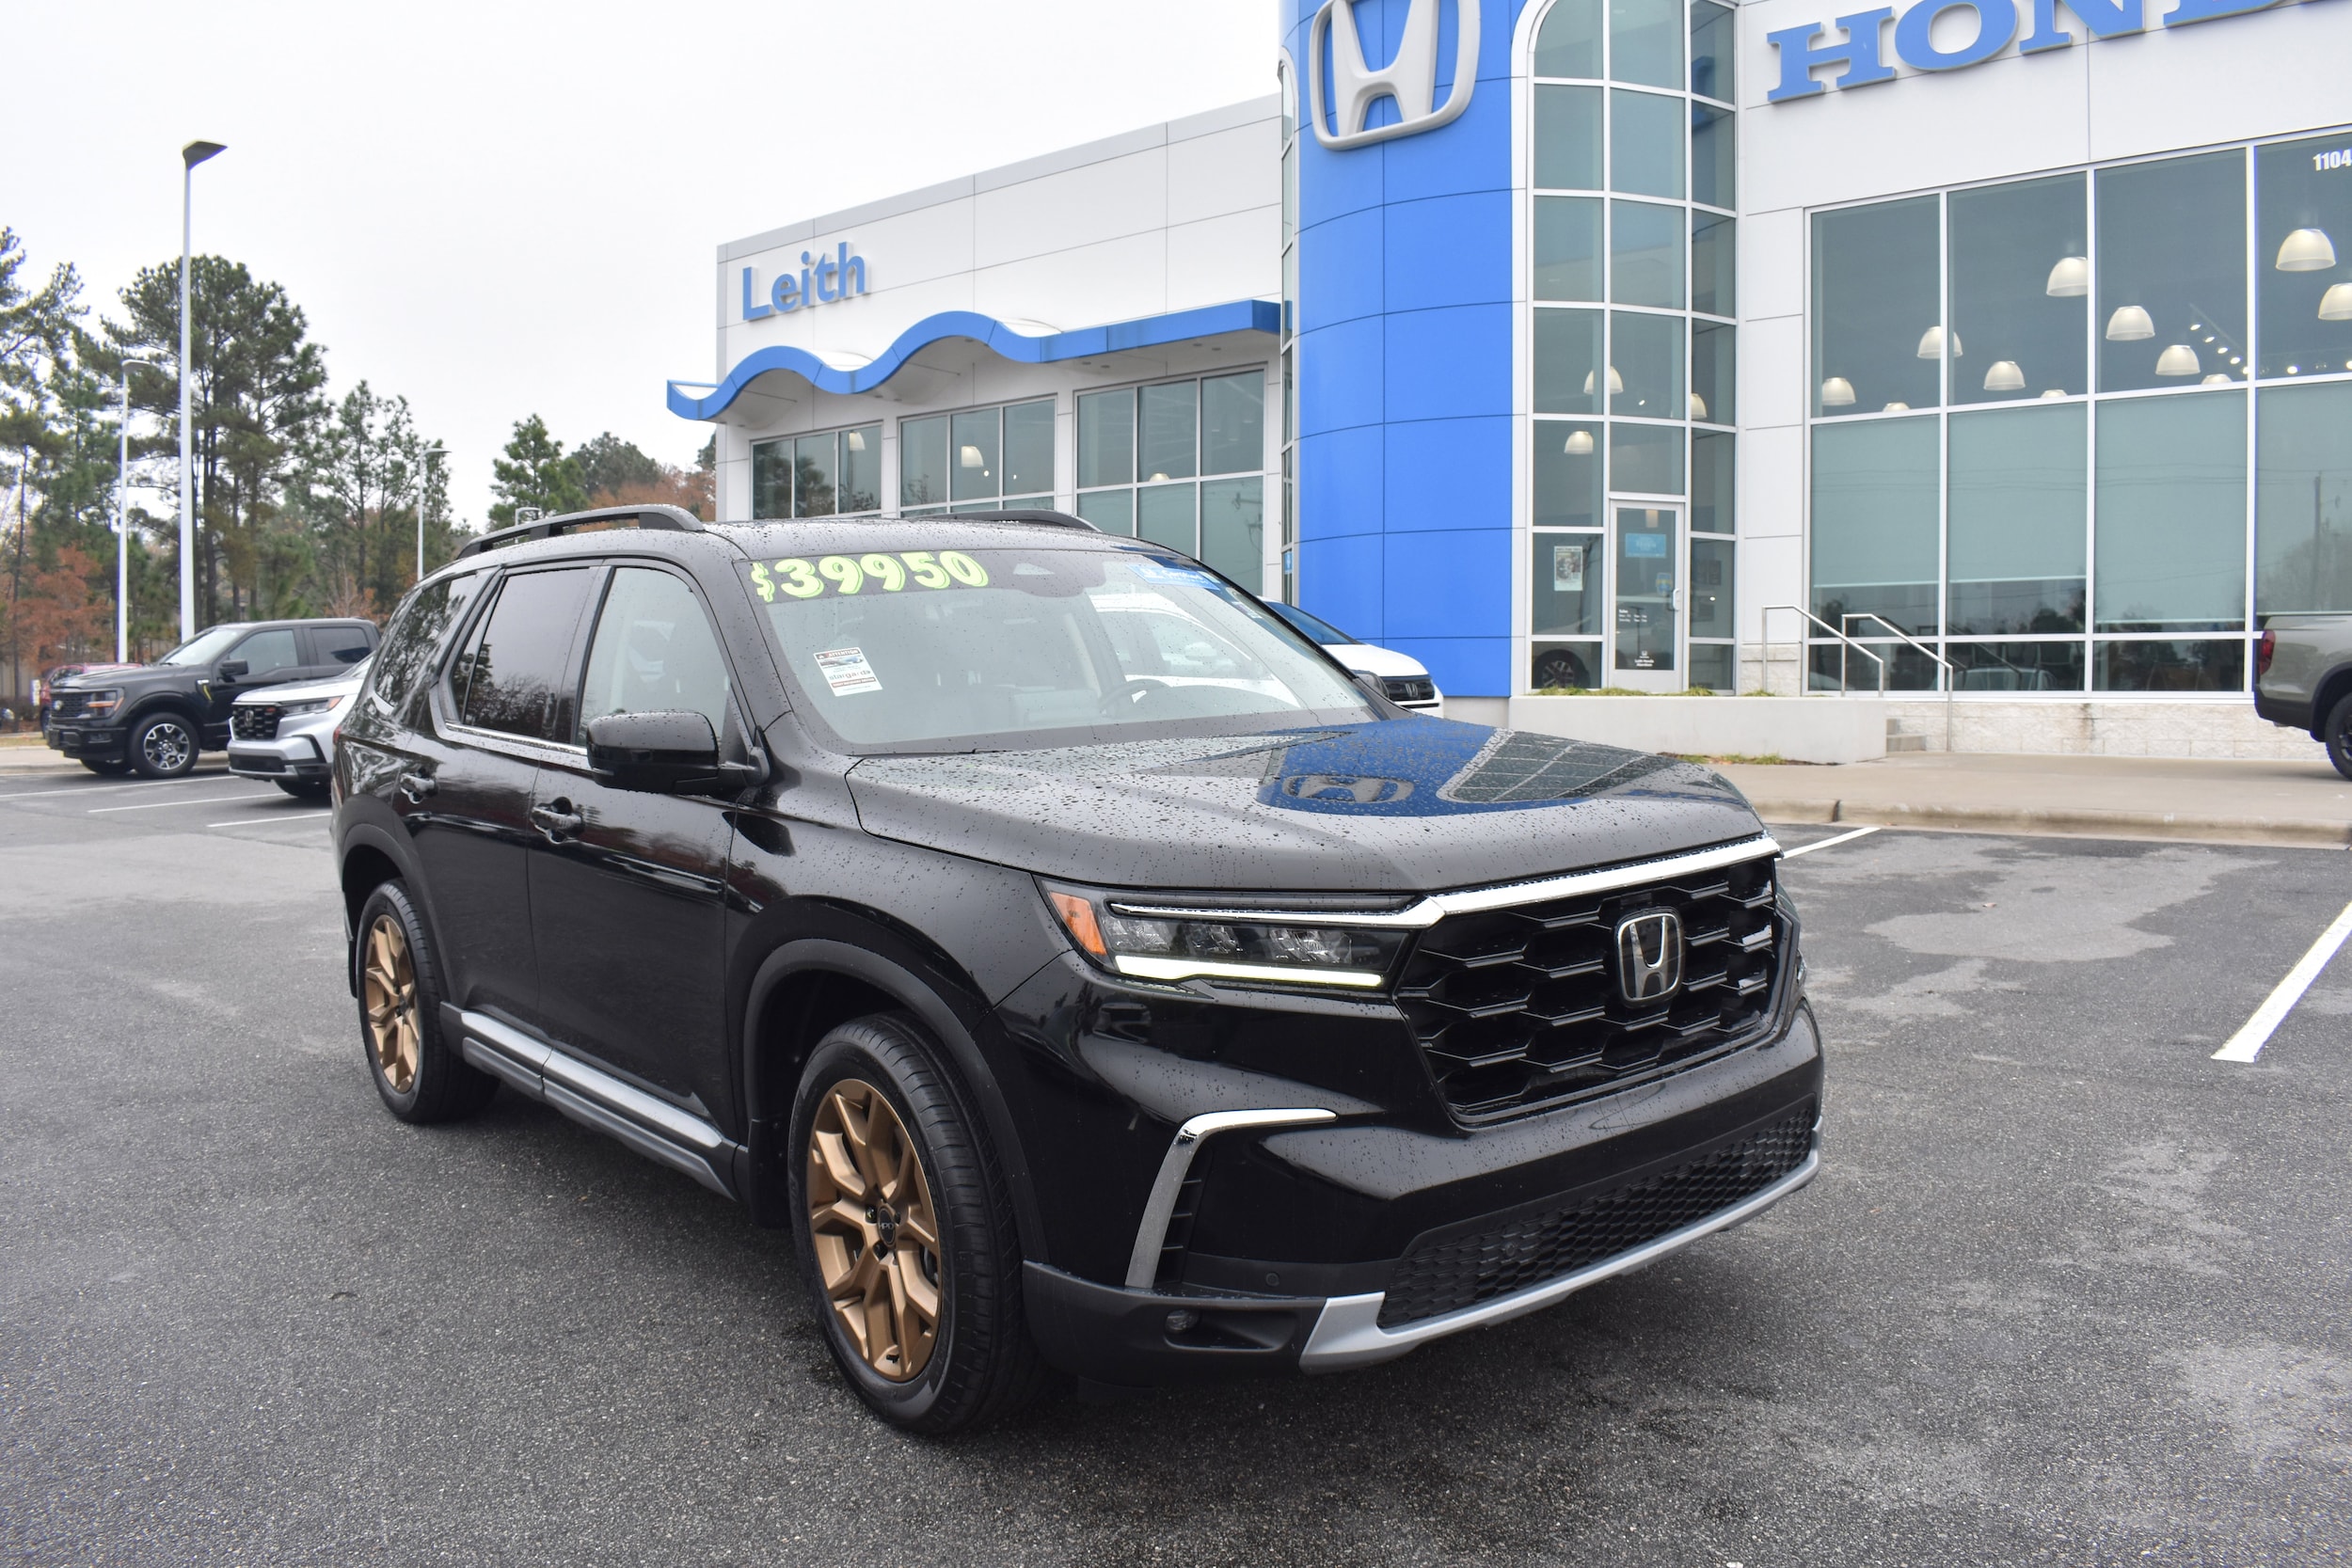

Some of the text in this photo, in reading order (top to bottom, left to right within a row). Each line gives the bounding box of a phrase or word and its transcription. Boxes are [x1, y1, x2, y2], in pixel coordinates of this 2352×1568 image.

[1767, 0, 2343, 103] HON
[742, 241, 868, 322] Leith
[750, 550, 989, 603] $39950
